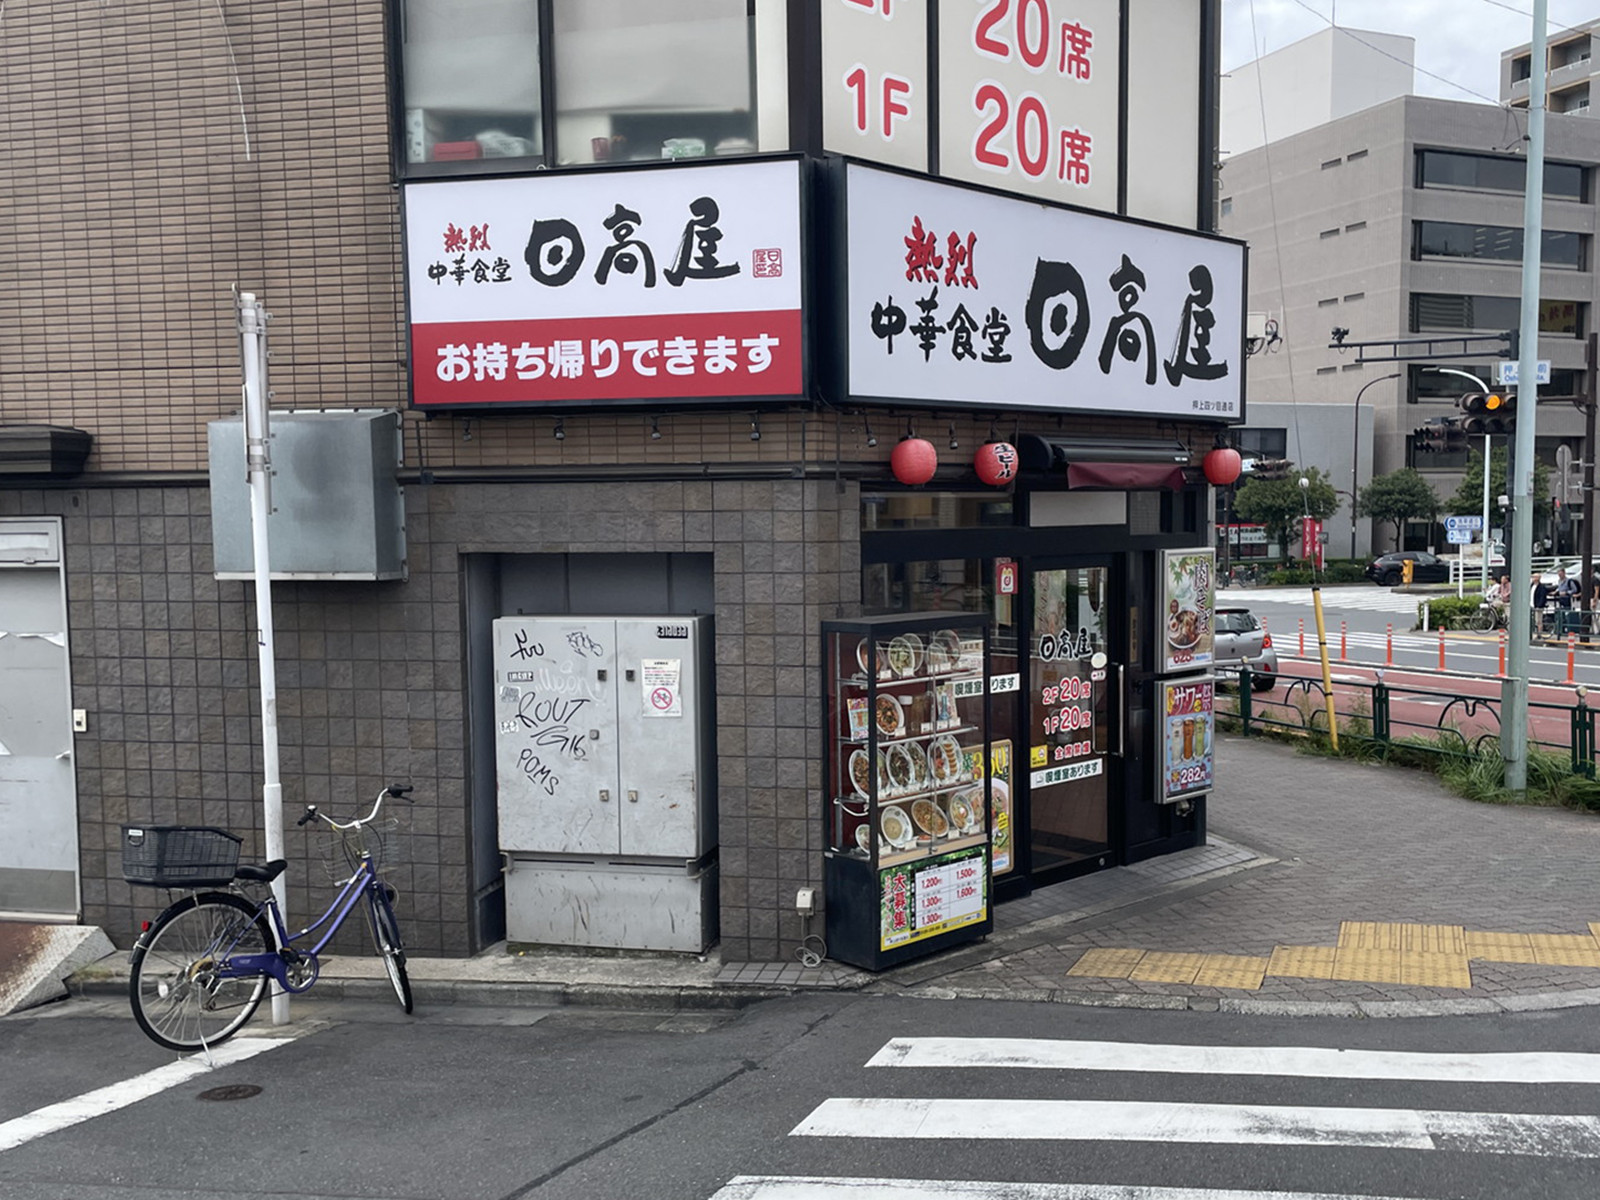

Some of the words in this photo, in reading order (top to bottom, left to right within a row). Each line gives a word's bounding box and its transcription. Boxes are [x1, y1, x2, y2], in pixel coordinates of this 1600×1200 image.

[846, 68, 910, 137] 1F
[975, 84, 1092, 185] 20席
[443, 222, 492, 253] 熱烈
[524, 196, 741, 288] 日高屋
[904, 215, 978, 290] 熱烈
[427, 253, 513, 285] 中華食堂
[870, 285, 1012, 364] 中華食堂
[1025, 253, 1229, 388] 日高屋
[436, 333, 780, 382] お持ち帰りできます
[994, 443, 1014, 479] 生ビール
[1040, 627, 1093, 661] 日高屋
[955, 677, 1015, 696] 喫煙室ります
[1045, 762, 1099, 783] 喫煙室あります
[893, 872, 907, 929] 大募集
